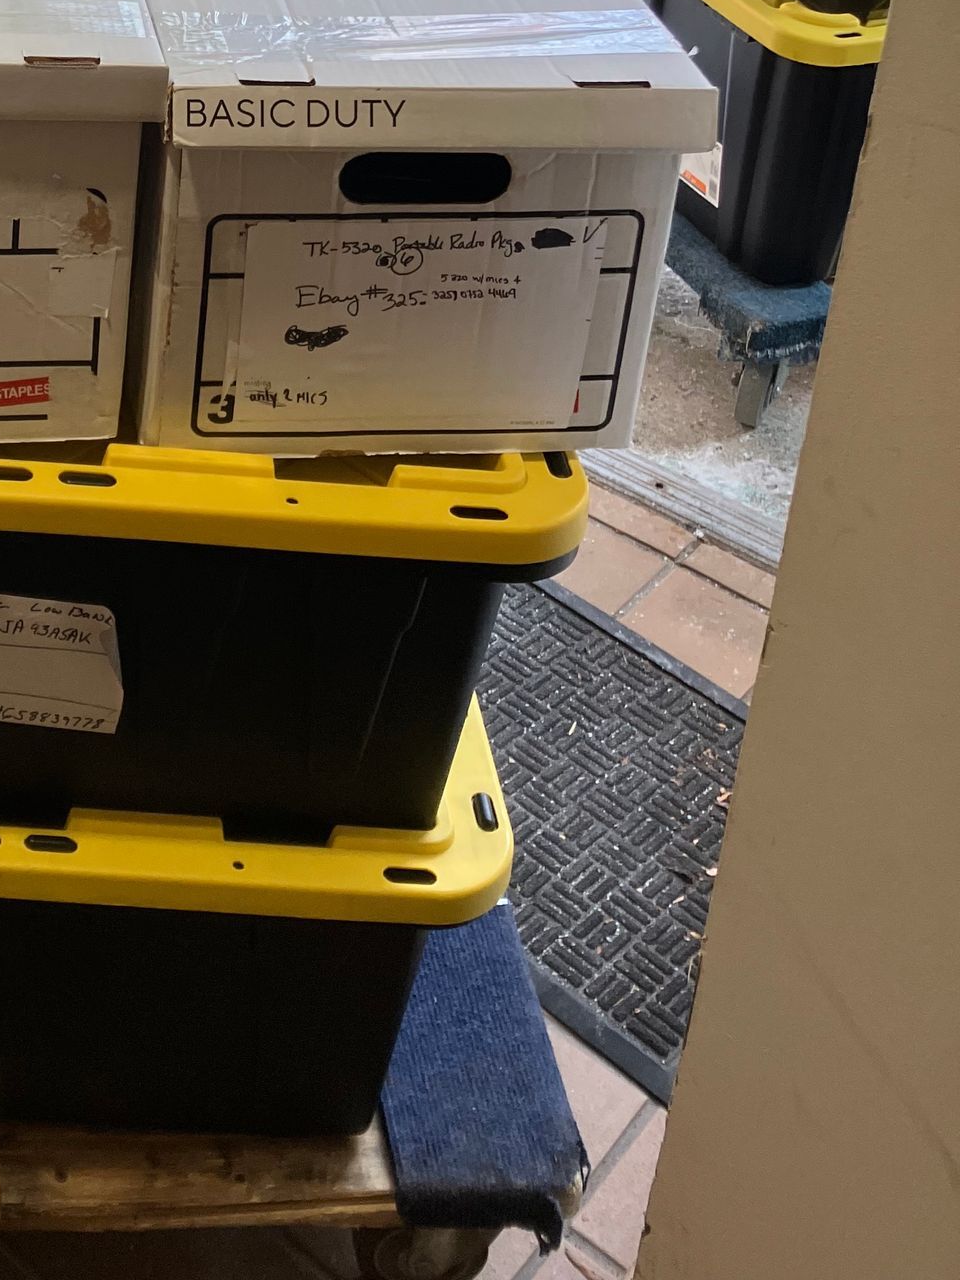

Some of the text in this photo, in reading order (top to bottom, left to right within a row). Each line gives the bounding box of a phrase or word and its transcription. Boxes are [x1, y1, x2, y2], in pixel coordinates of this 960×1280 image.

[186, 98, 407, 128] BASIC DUTY
[303, 239, 383, 258] TK-5320
[450, 230, 485, 251] Radio
[296, 286, 361, 316] Ebay
[282, 388, 294, 402] 2
